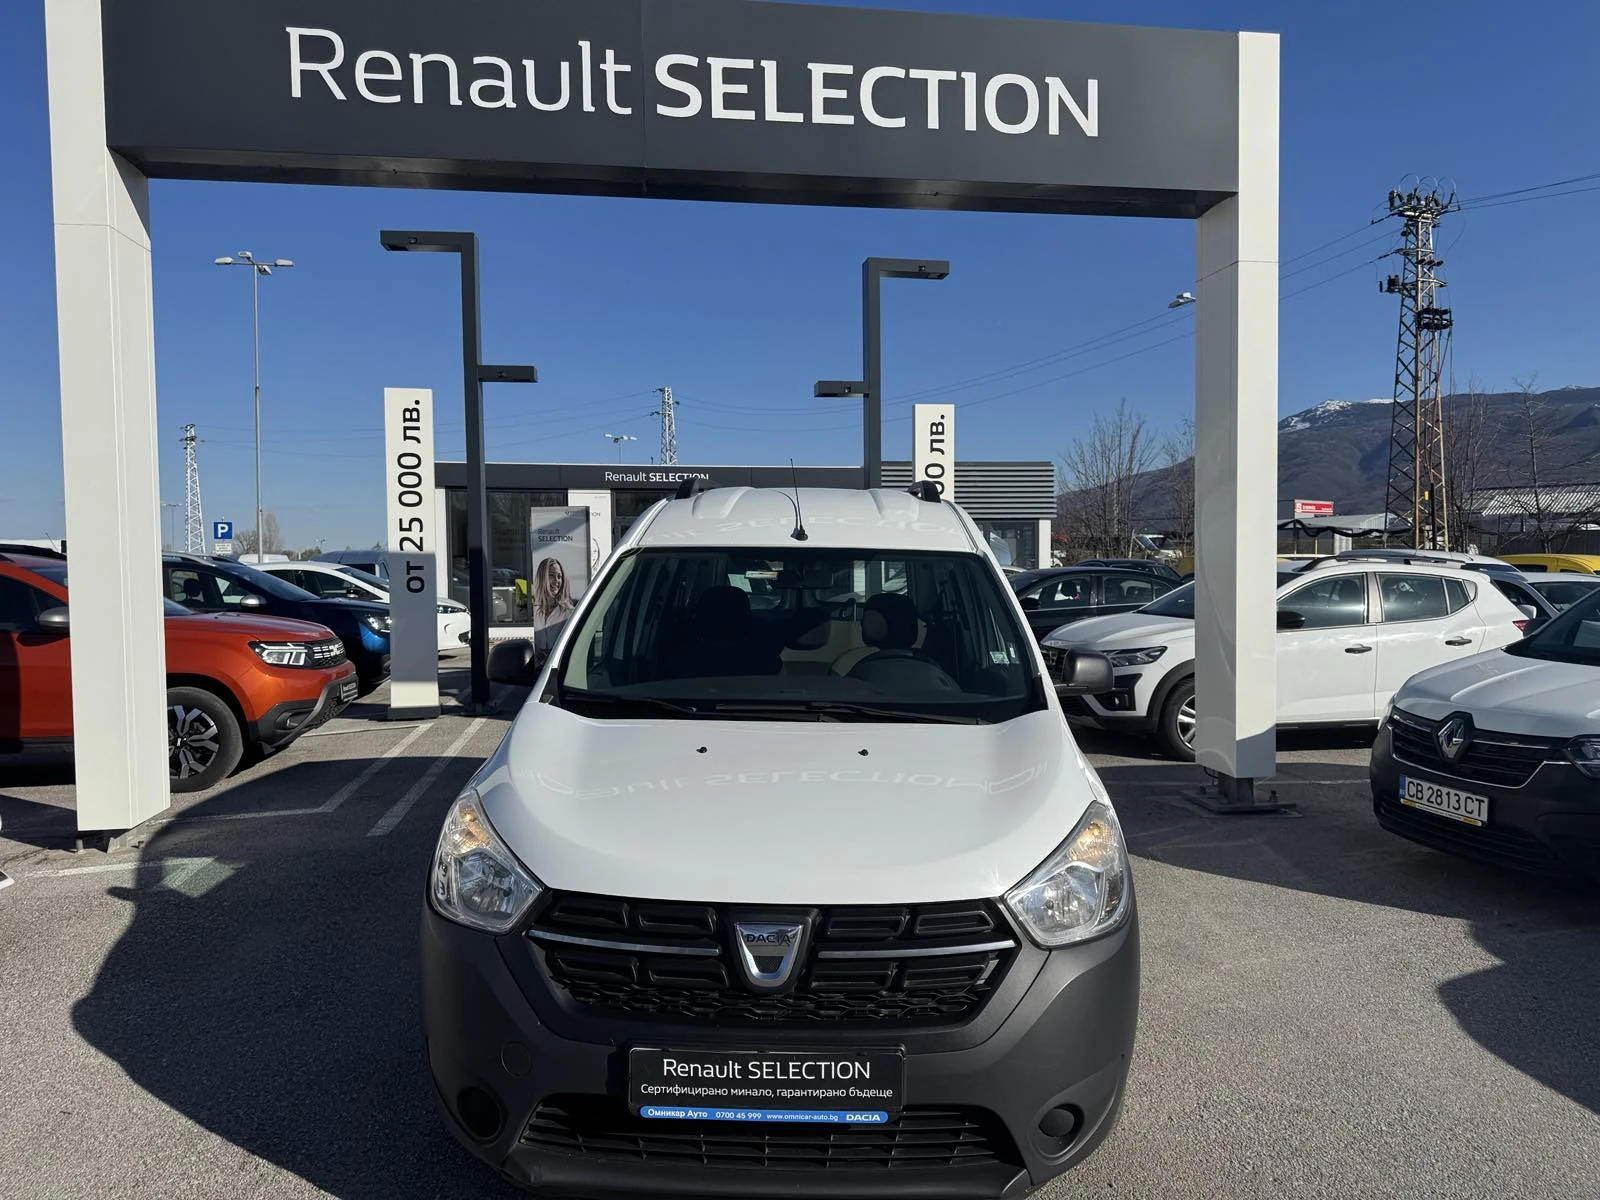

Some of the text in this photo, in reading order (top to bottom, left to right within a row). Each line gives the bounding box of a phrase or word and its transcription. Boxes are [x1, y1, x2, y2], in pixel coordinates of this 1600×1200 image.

[285, 26, 1099, 137] Renault SELECTION
[402, 399, 421, 444] лв.
[929, 414, 945, 455] лв.
[397, 452, 423, 508] 000
[605, 471, 647, 482] Renault
[217, 523, 229, 538] P
[399, 517, 424, 552] 25
[1426, 786, 1461, 811] 2813
[746, 933, 791, 944] DACIA
[663, 1058, 870, 1079] Renault SELECTION
[640, 1083, 893, 1099] Сертифицирано минало, гарантирано бъдеще
[647, 1108, 881, 1122] Омникар Ауто 0700 45 999 www.omnicar-auto.bg DACIA
